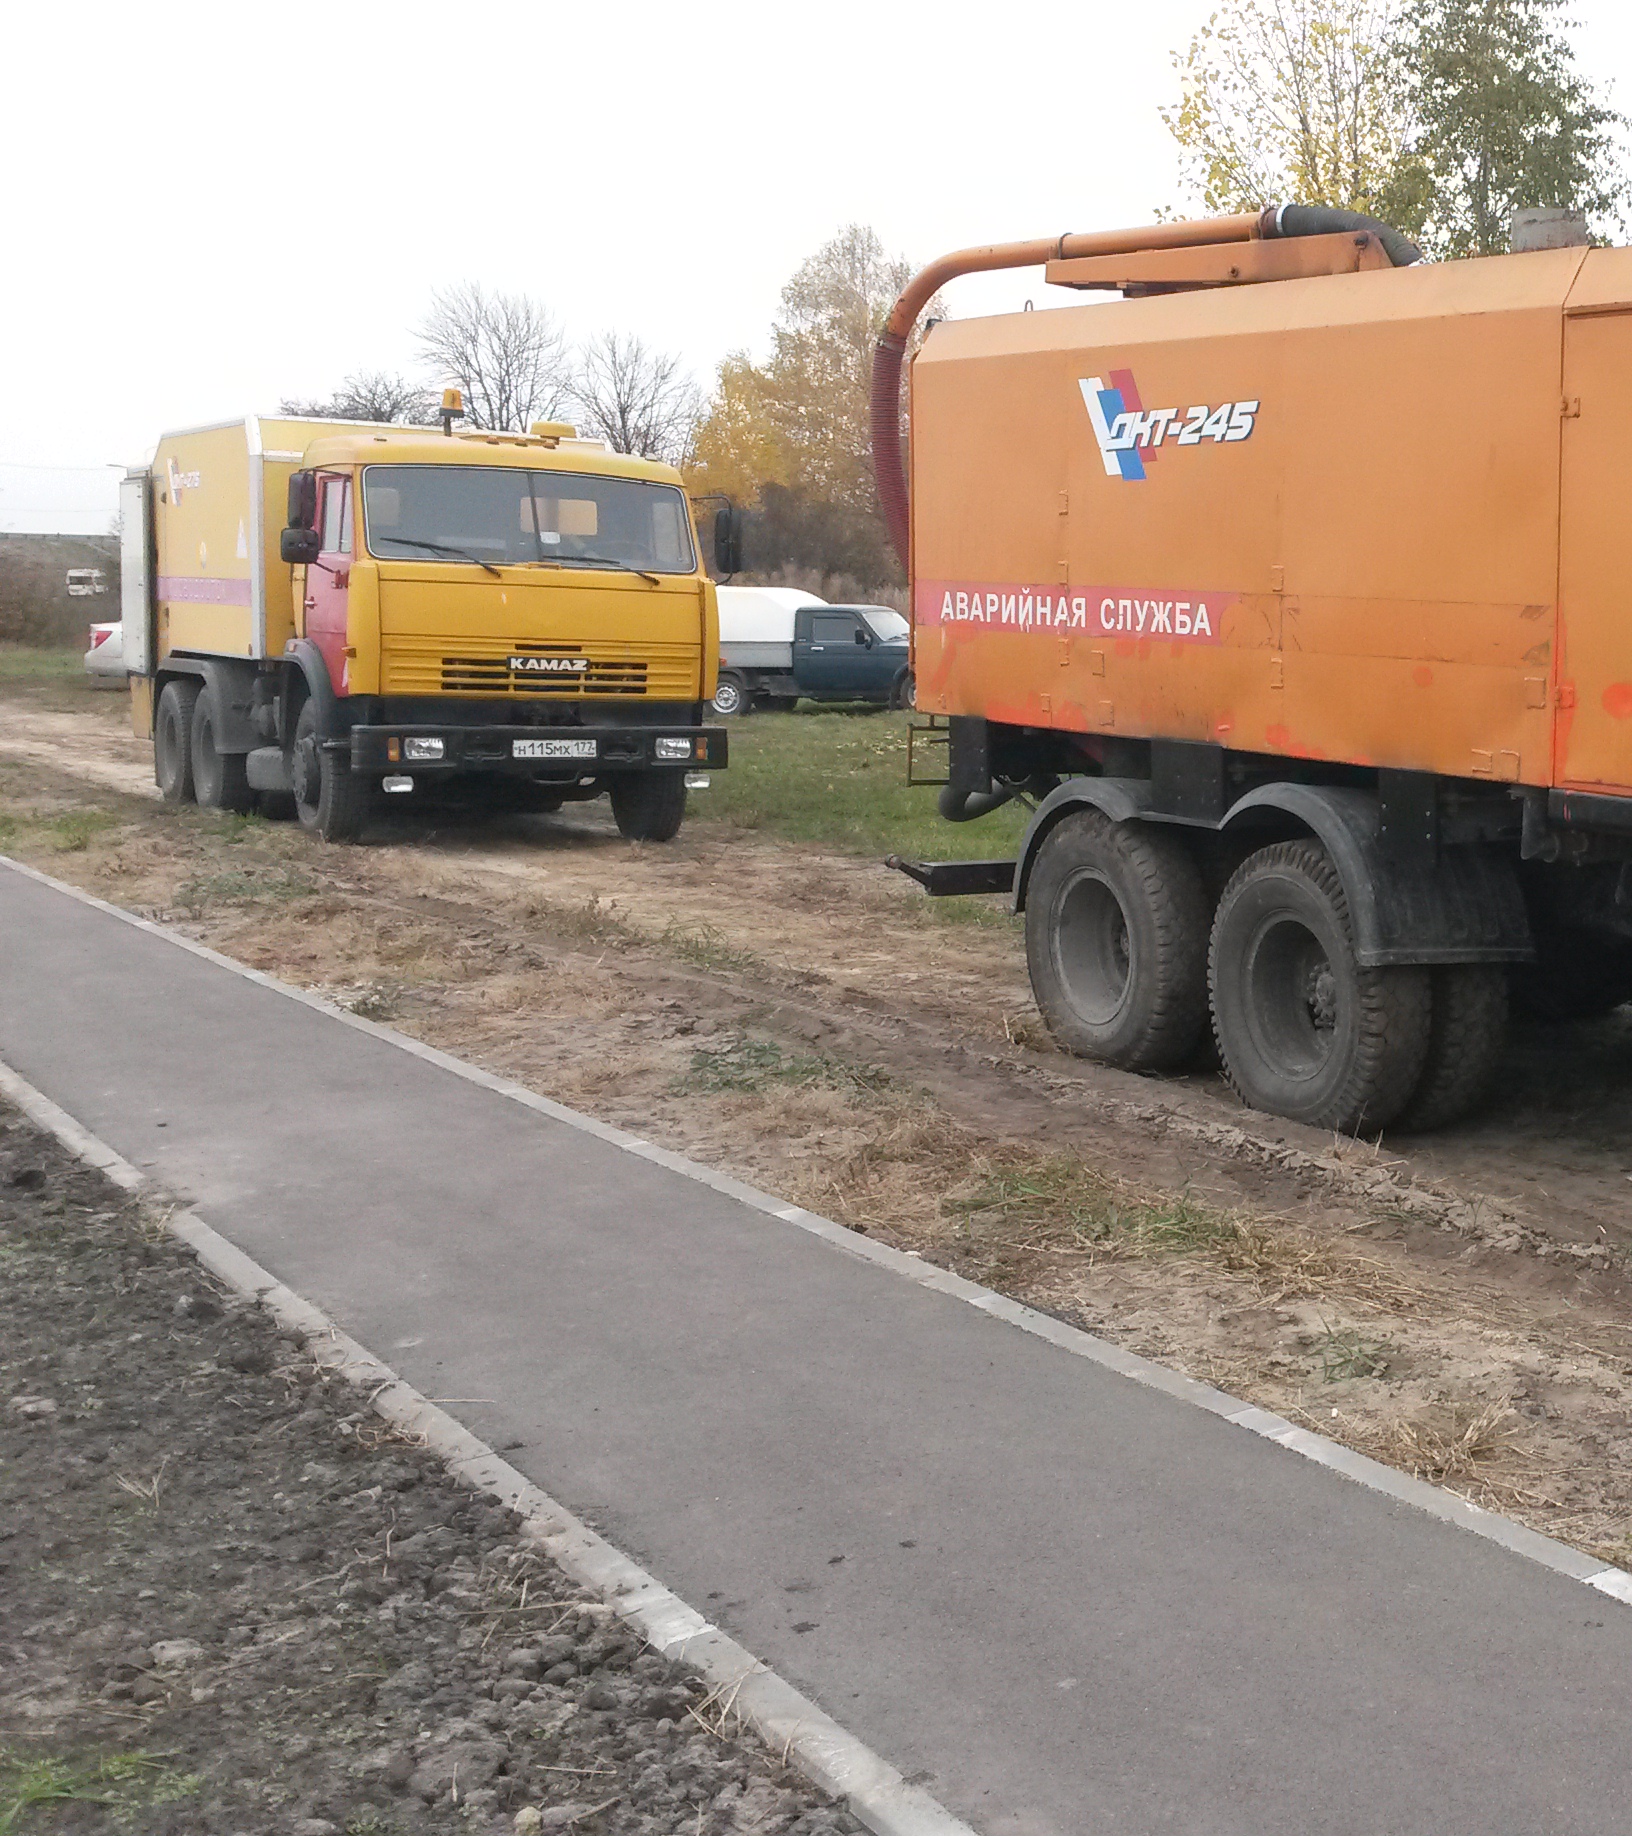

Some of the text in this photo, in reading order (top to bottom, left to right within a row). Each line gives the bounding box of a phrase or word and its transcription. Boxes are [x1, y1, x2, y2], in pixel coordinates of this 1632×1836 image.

[941, 587, 1212, 637] АВАРИЙНАЯ СЛУЖБА
[510, 657, 588, 671] KAMAZ
[518, 741, 593, 755] Н115МХ 177
